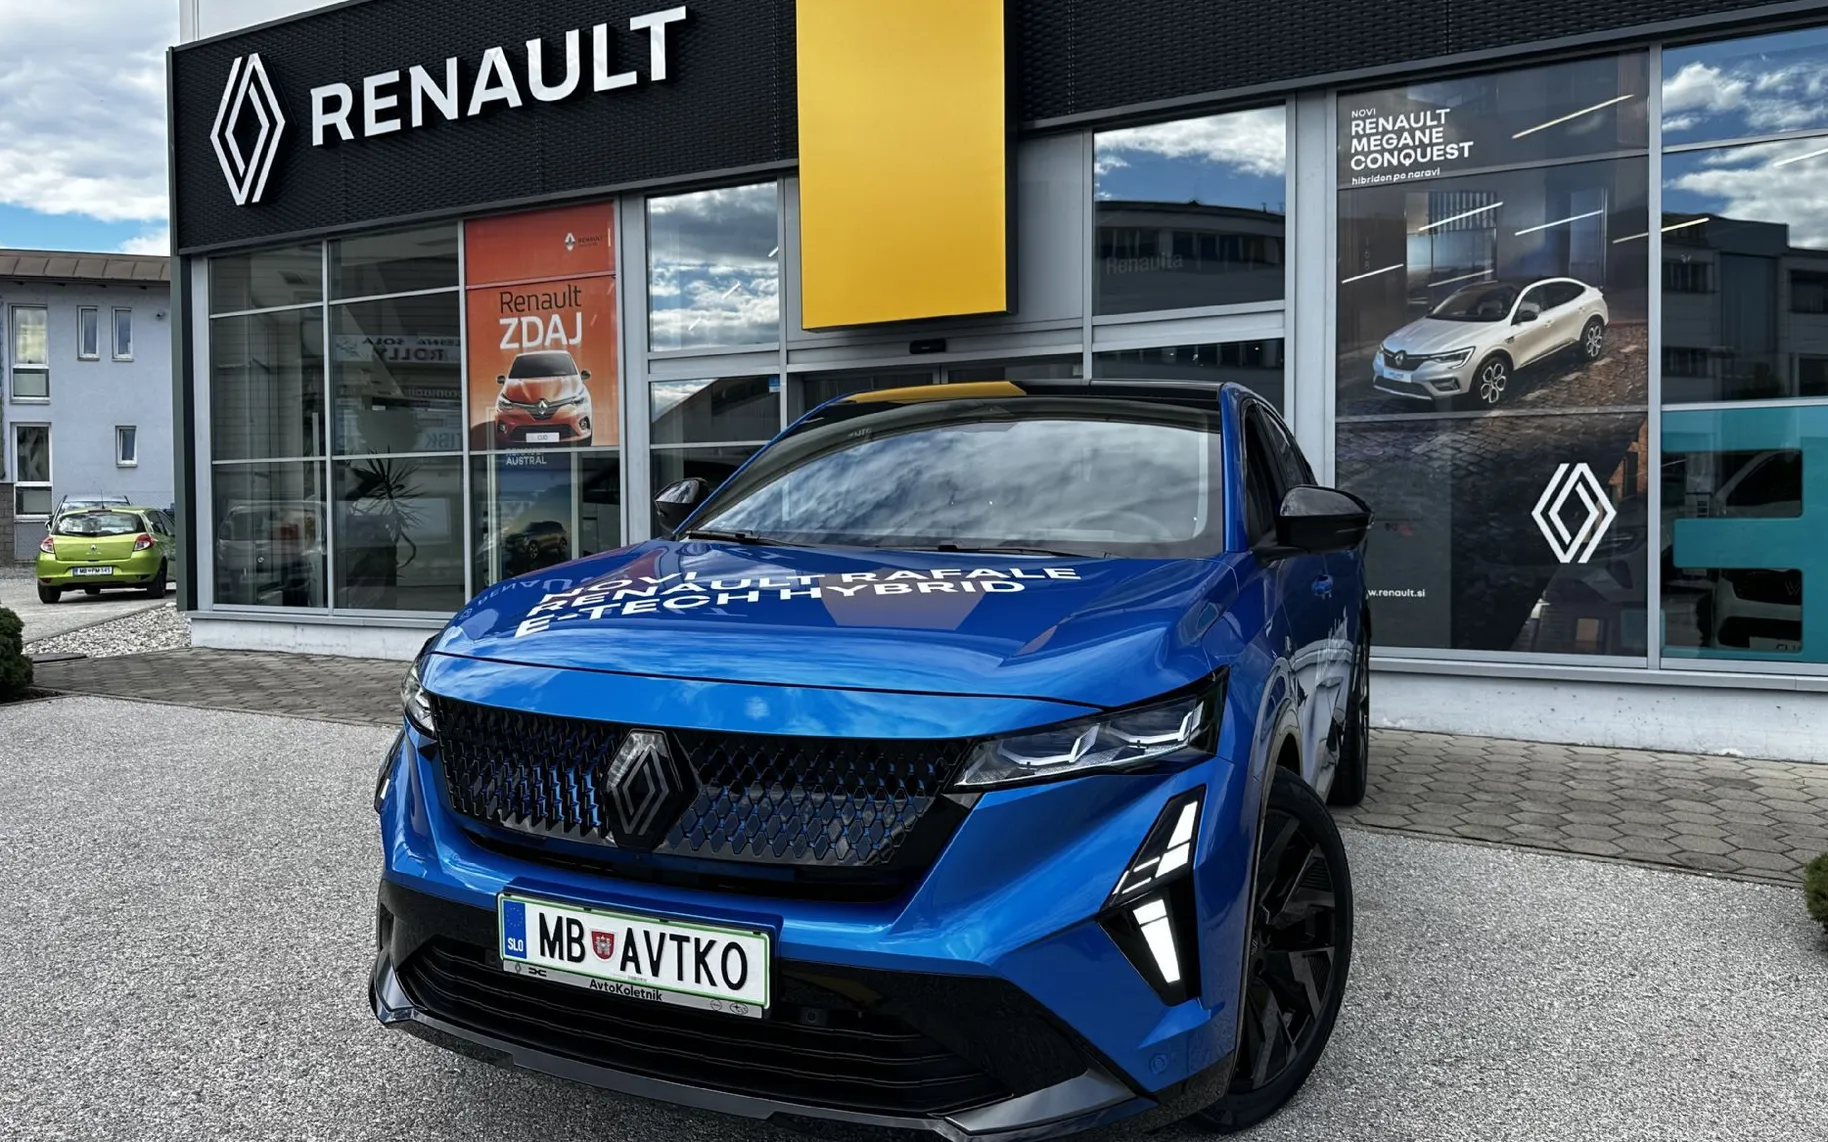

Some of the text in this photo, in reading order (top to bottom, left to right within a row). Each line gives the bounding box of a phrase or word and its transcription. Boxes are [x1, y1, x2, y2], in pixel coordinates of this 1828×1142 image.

[310, 5, 687, 146] RENAULT
[1351, 108, 1376, 118] NOVI
[1351, 108, 1451, 136] RENAULT
[1351, 127, 1444, 153] MEGANE
[1350, 141, 1474, 171] CONQUEST
[1393, 173, 1406, 182] po
[1408, 167, 1441, 179] naravi
[500, 284, 581, 313] Renault
[499, 312, 582, 349] ZDAJ
[506, 455, 547, 466] AUSTRAL
[527, 568, 1081, 617] RENAULT RAFALE
[538, 571, 697, 604] NOVI
[514, 580, 1025, 638] E-TECH HYBRID
[507, 936, 524, 952] SLO
[538, 912, 748, 991] MB AVTKO
[589, 978, 663, 1002] AvtoKoletnik
